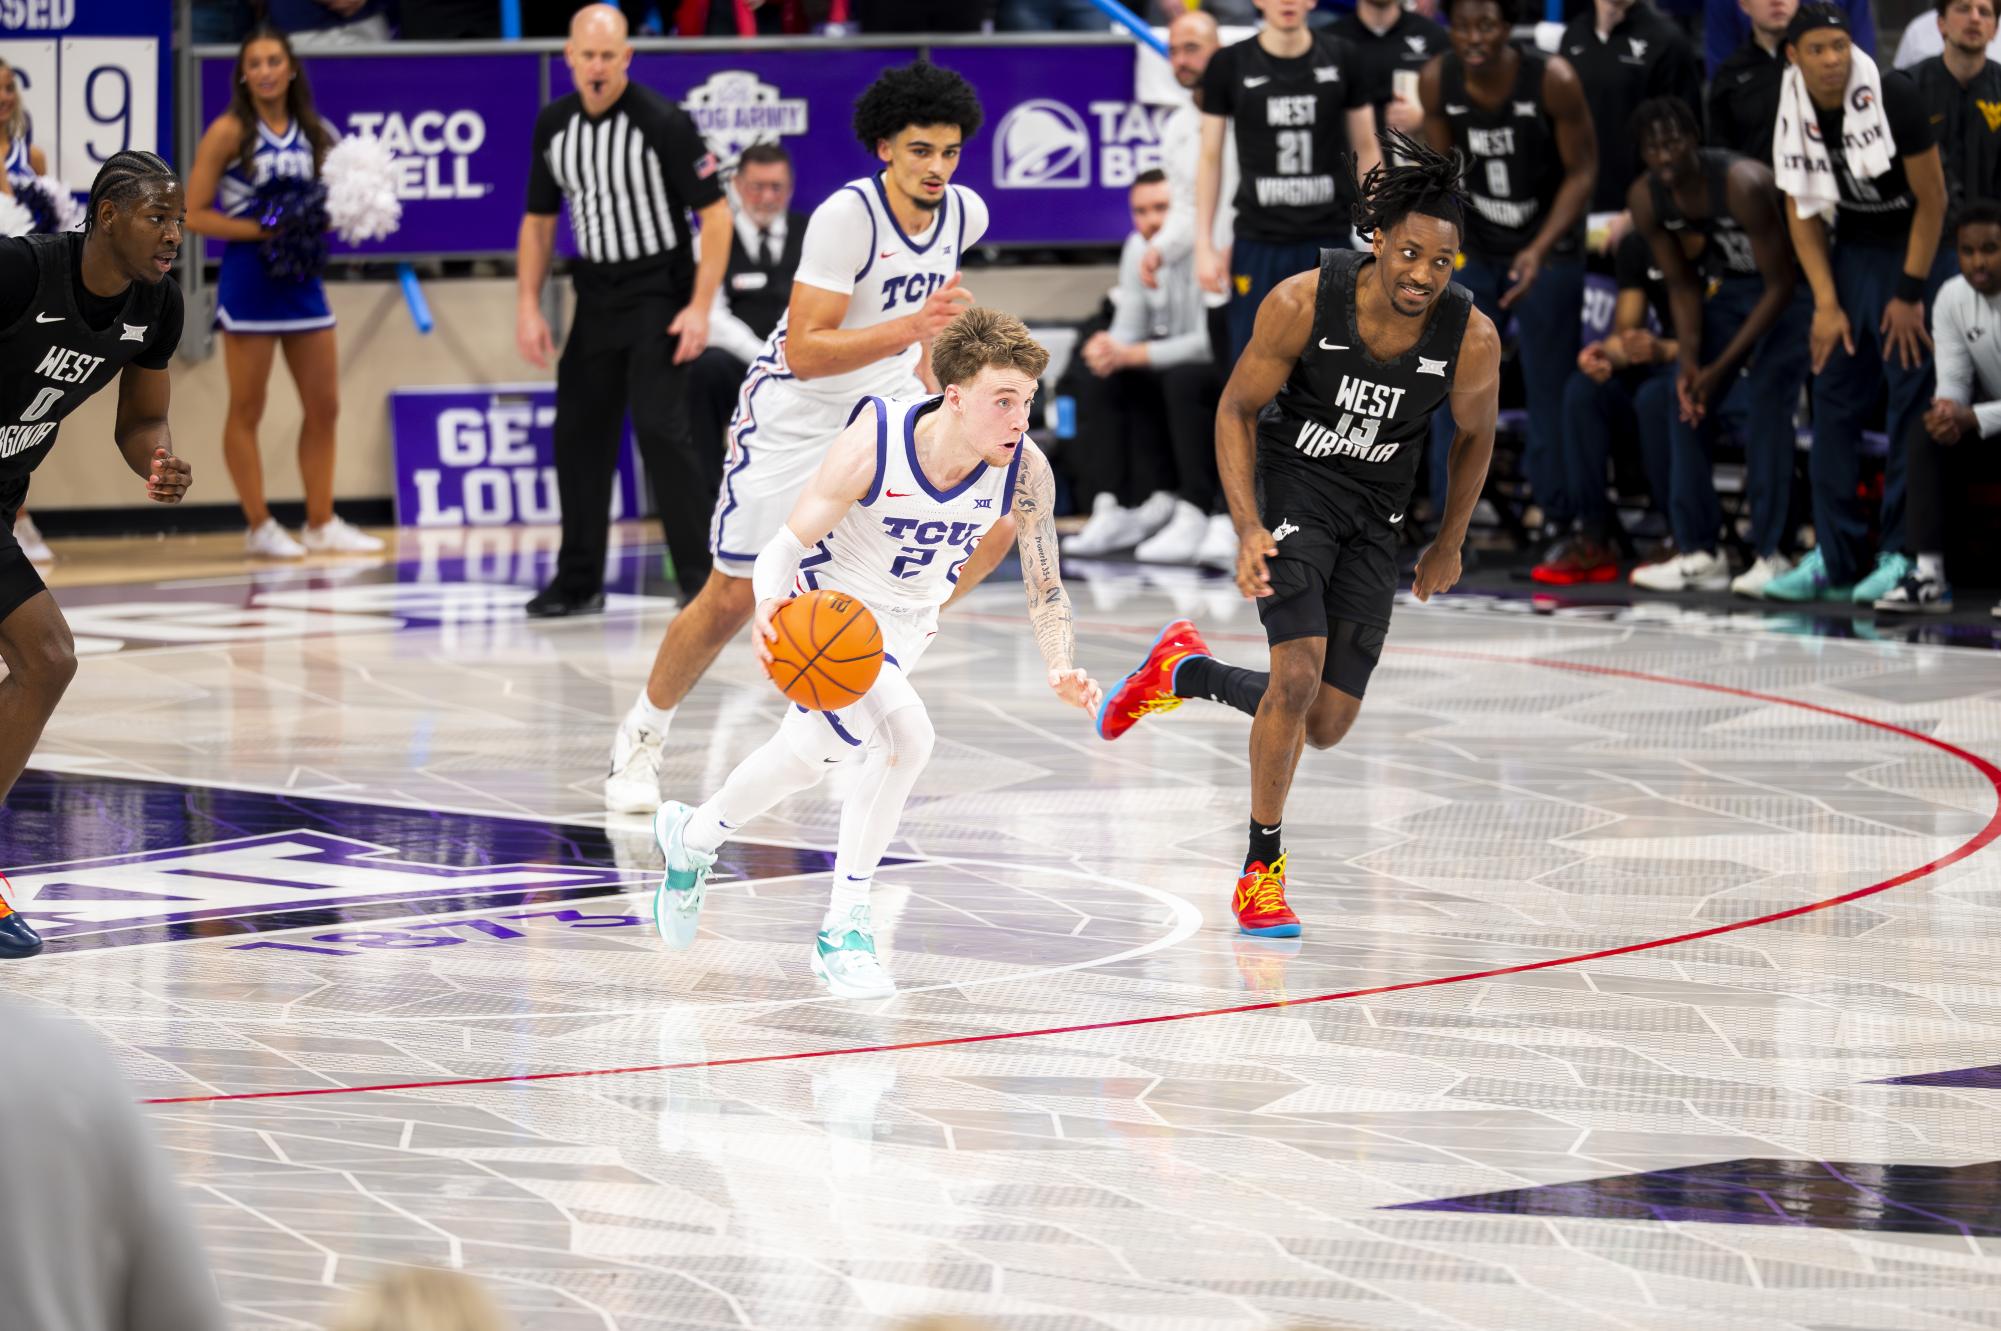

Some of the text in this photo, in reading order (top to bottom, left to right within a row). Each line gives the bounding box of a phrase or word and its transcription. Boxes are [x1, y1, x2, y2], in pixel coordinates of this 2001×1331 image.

[0, 0, 76, 30] SED
[84, 63, 132, 164] 9
[348, 110, 487, 155] TACO
[1276, 130, 1313, 175] 21
[396, 155, 486, 200] ELL
[34, 345, 106, 384] WEST
[20, 386, 65, 421] 0
[1334, 374, 1406, 419] WEST
[972, 498, 993, 510] XII
[882, 516, 983, 546] TCU
[889, 546, 939, 580] 2
[226, 908, 657, 956] 1873
